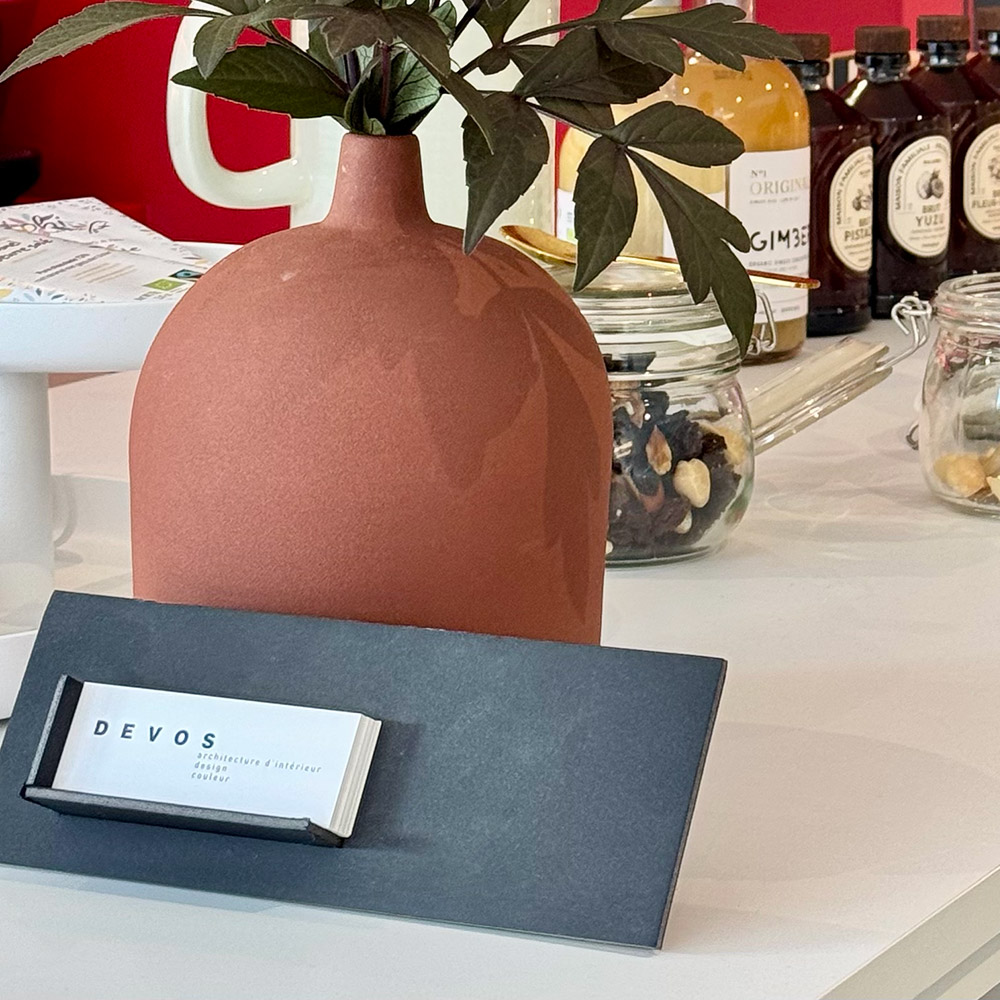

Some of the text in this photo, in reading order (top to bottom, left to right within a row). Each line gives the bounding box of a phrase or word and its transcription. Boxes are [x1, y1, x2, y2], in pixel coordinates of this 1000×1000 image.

[915, 213, 945, 227] YUZU
[750, 225, 809, 252] GIMBE
[93, 720, 216, 749] DEVOS
[194, 761, 228, 772] design
[197, 752, 322, 773] architecture d'intérieur
[191, 772, 230, 783] couleur
